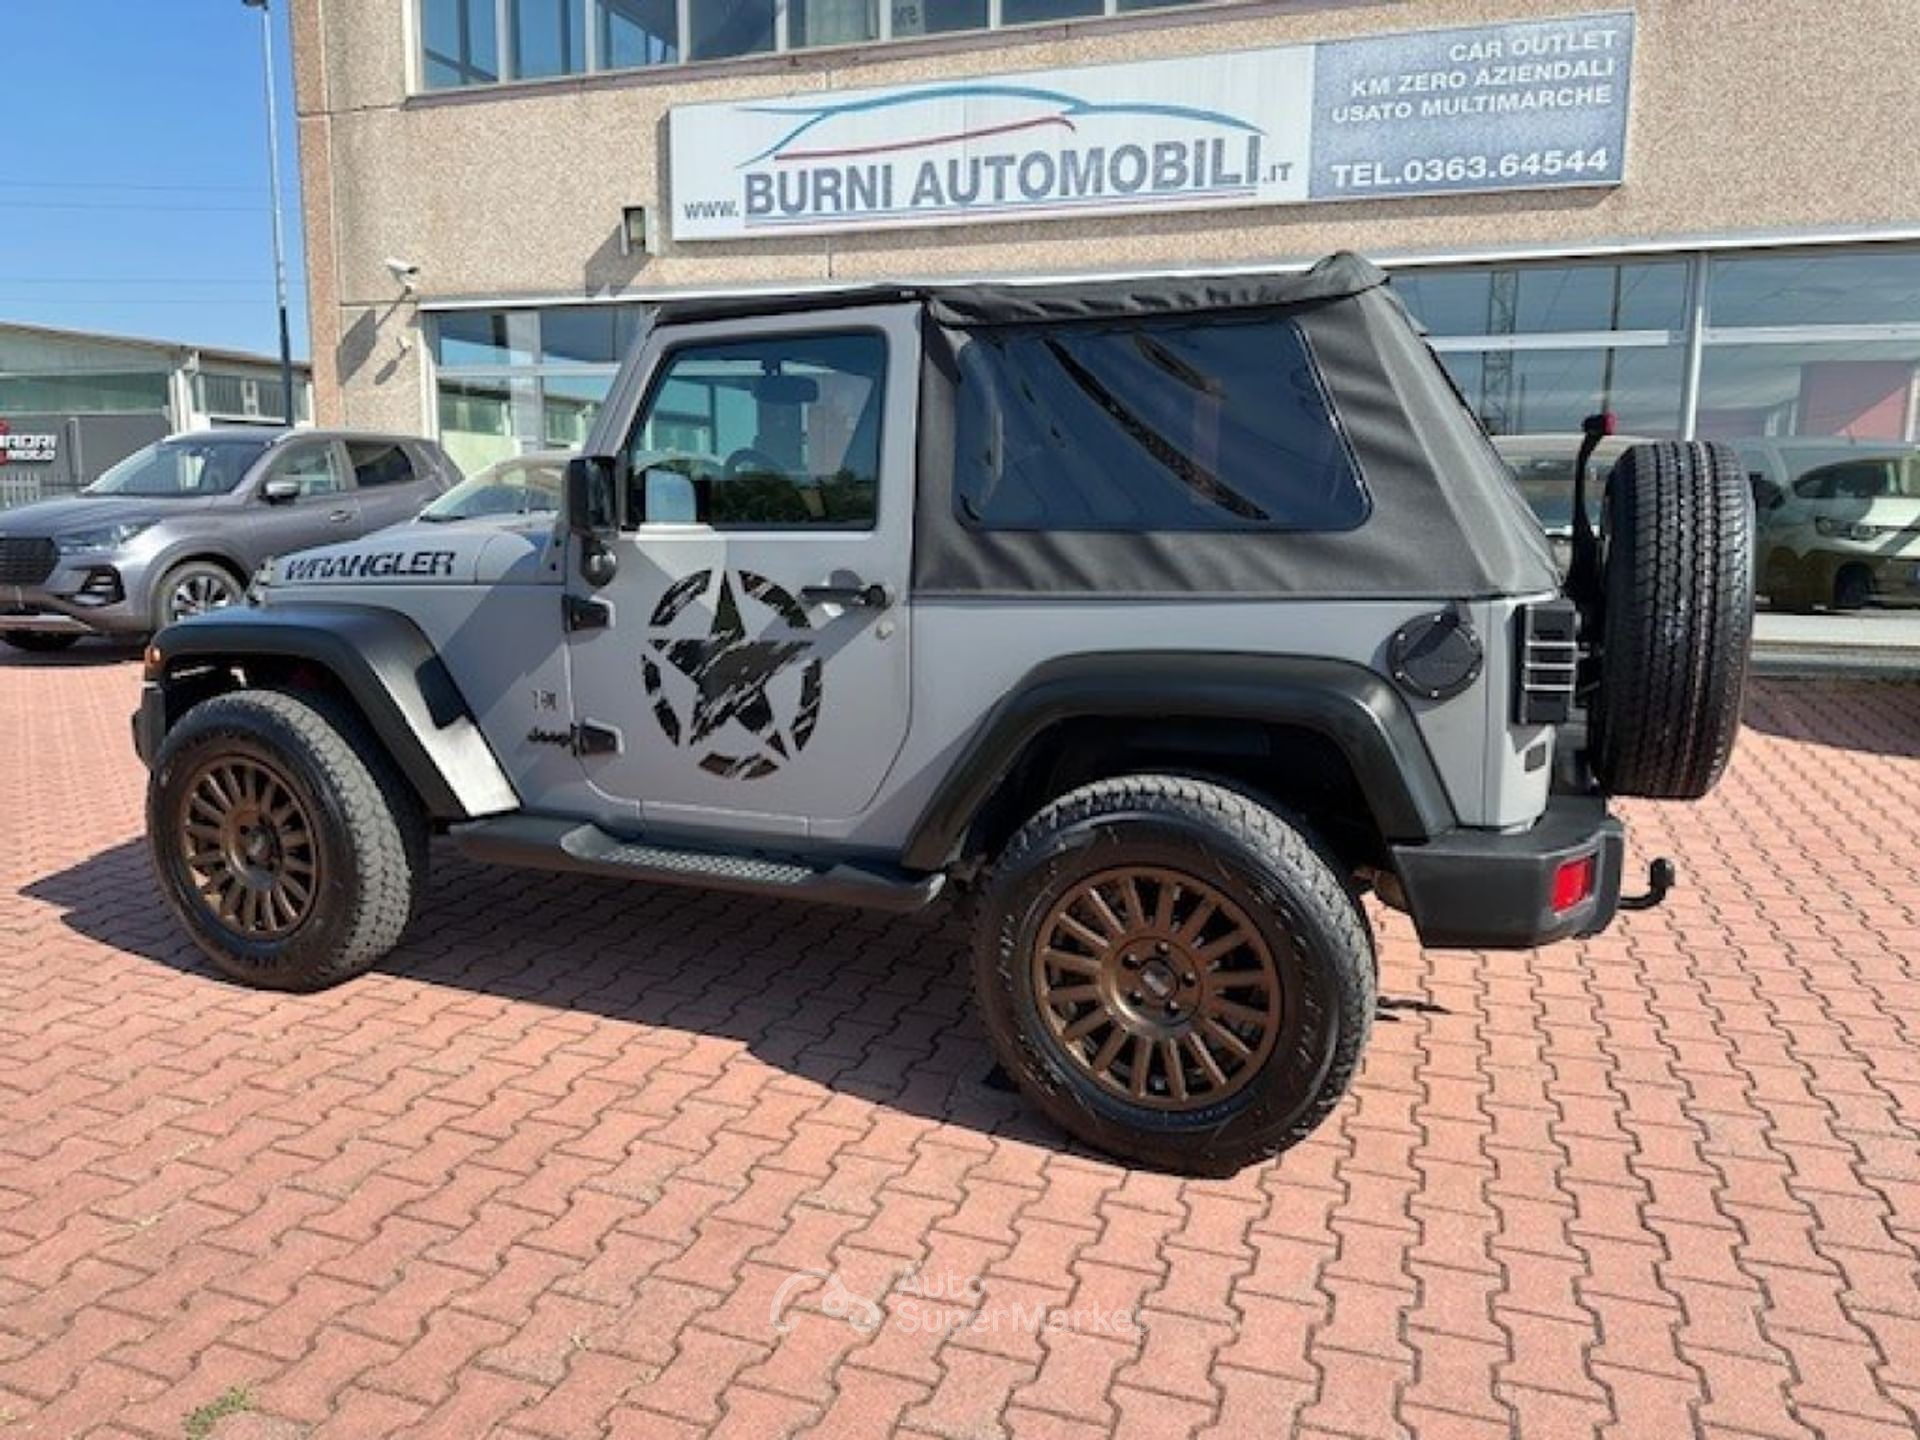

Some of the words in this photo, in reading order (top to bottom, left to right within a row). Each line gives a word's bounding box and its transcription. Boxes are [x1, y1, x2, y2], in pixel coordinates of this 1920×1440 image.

[1450, 40, 1502, 63] CAR
[1512, 29, 1617, 56] OUTLET
[1351, 77, 1391, 98] KM
[1399, 69, 1466, 93] ZERO
[1474, 57, 1613, 87] AZIENDALI
[1332, 102, 1411, 124] USATO
[1421, 84, 1612, 117] MULTIMARCHE
[1331, 147, 1609, 188] TEL.0363.64544
[745, 163, 893, 216] BURNI
[285, 551, 456, 581] WRANGLER
